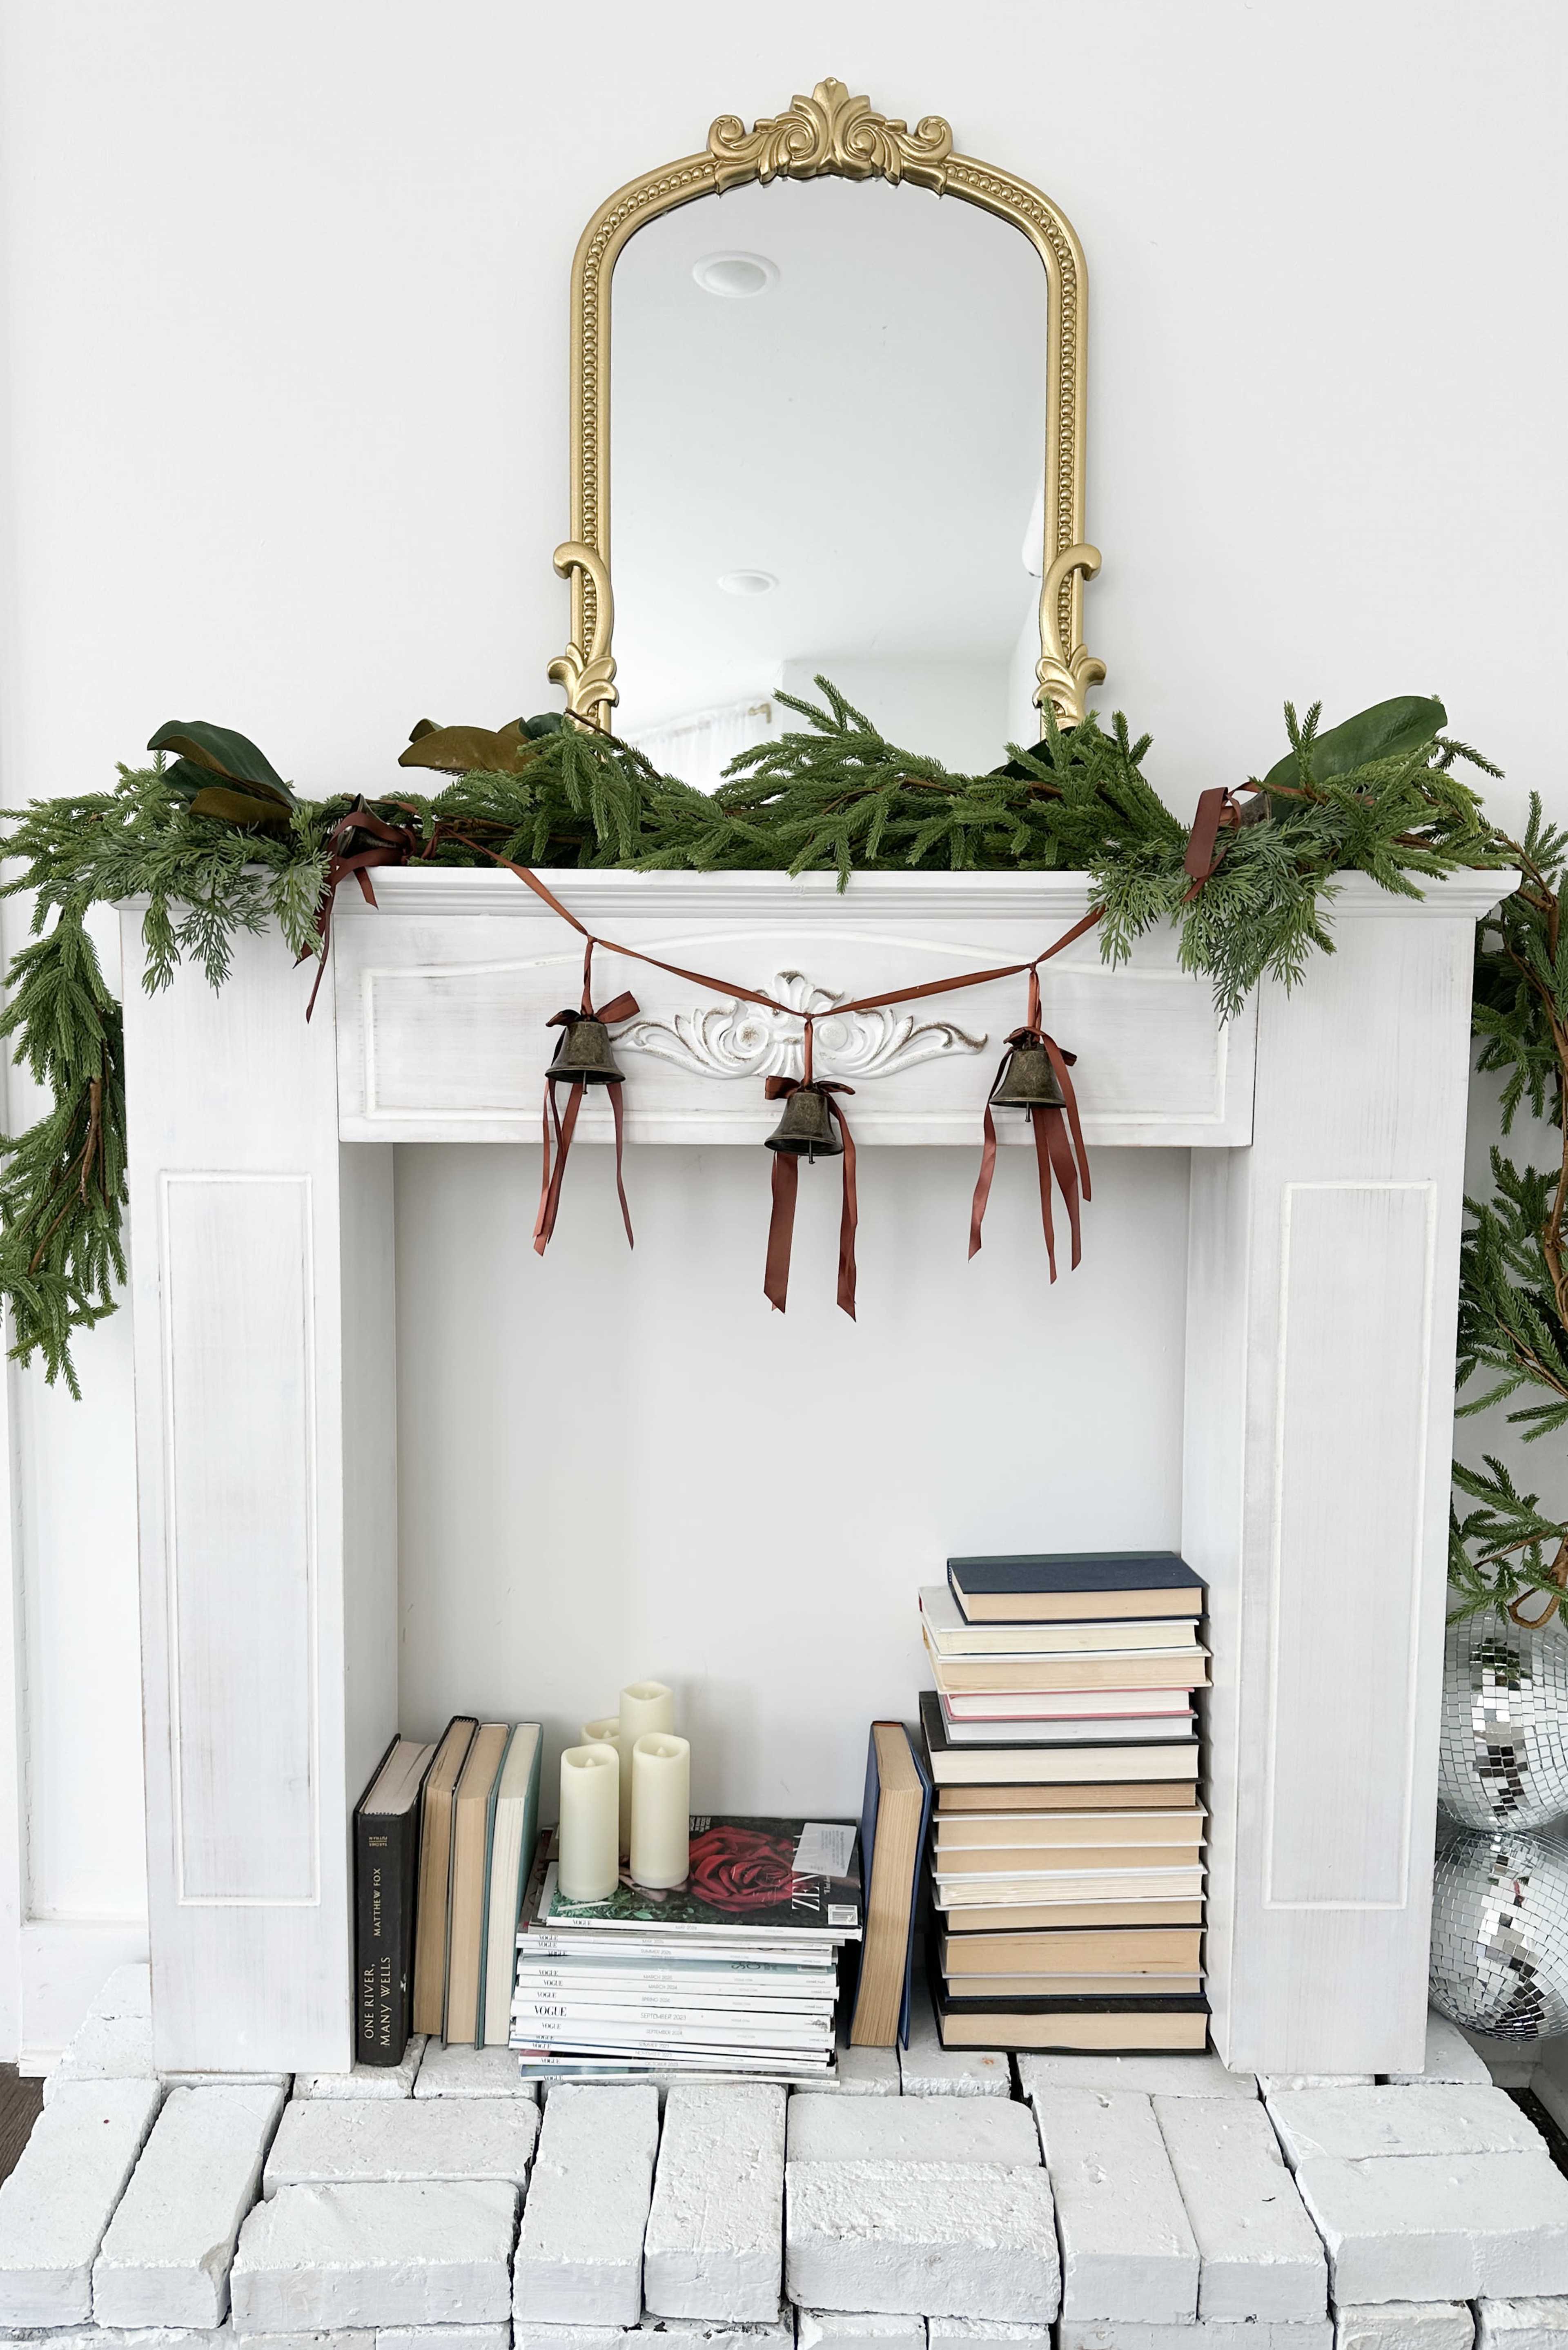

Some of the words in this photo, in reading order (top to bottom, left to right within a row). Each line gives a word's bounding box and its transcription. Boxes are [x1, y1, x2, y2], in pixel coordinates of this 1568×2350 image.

[364, 1964, 375, 2007] RIVER,
[381, 1957, 390, 1997] WELLS
[364, 2013, 374, 2039] ONE
[381, 2004, 392, 2046] MANY
[535, 2005, 567, 2016] VOGUE
